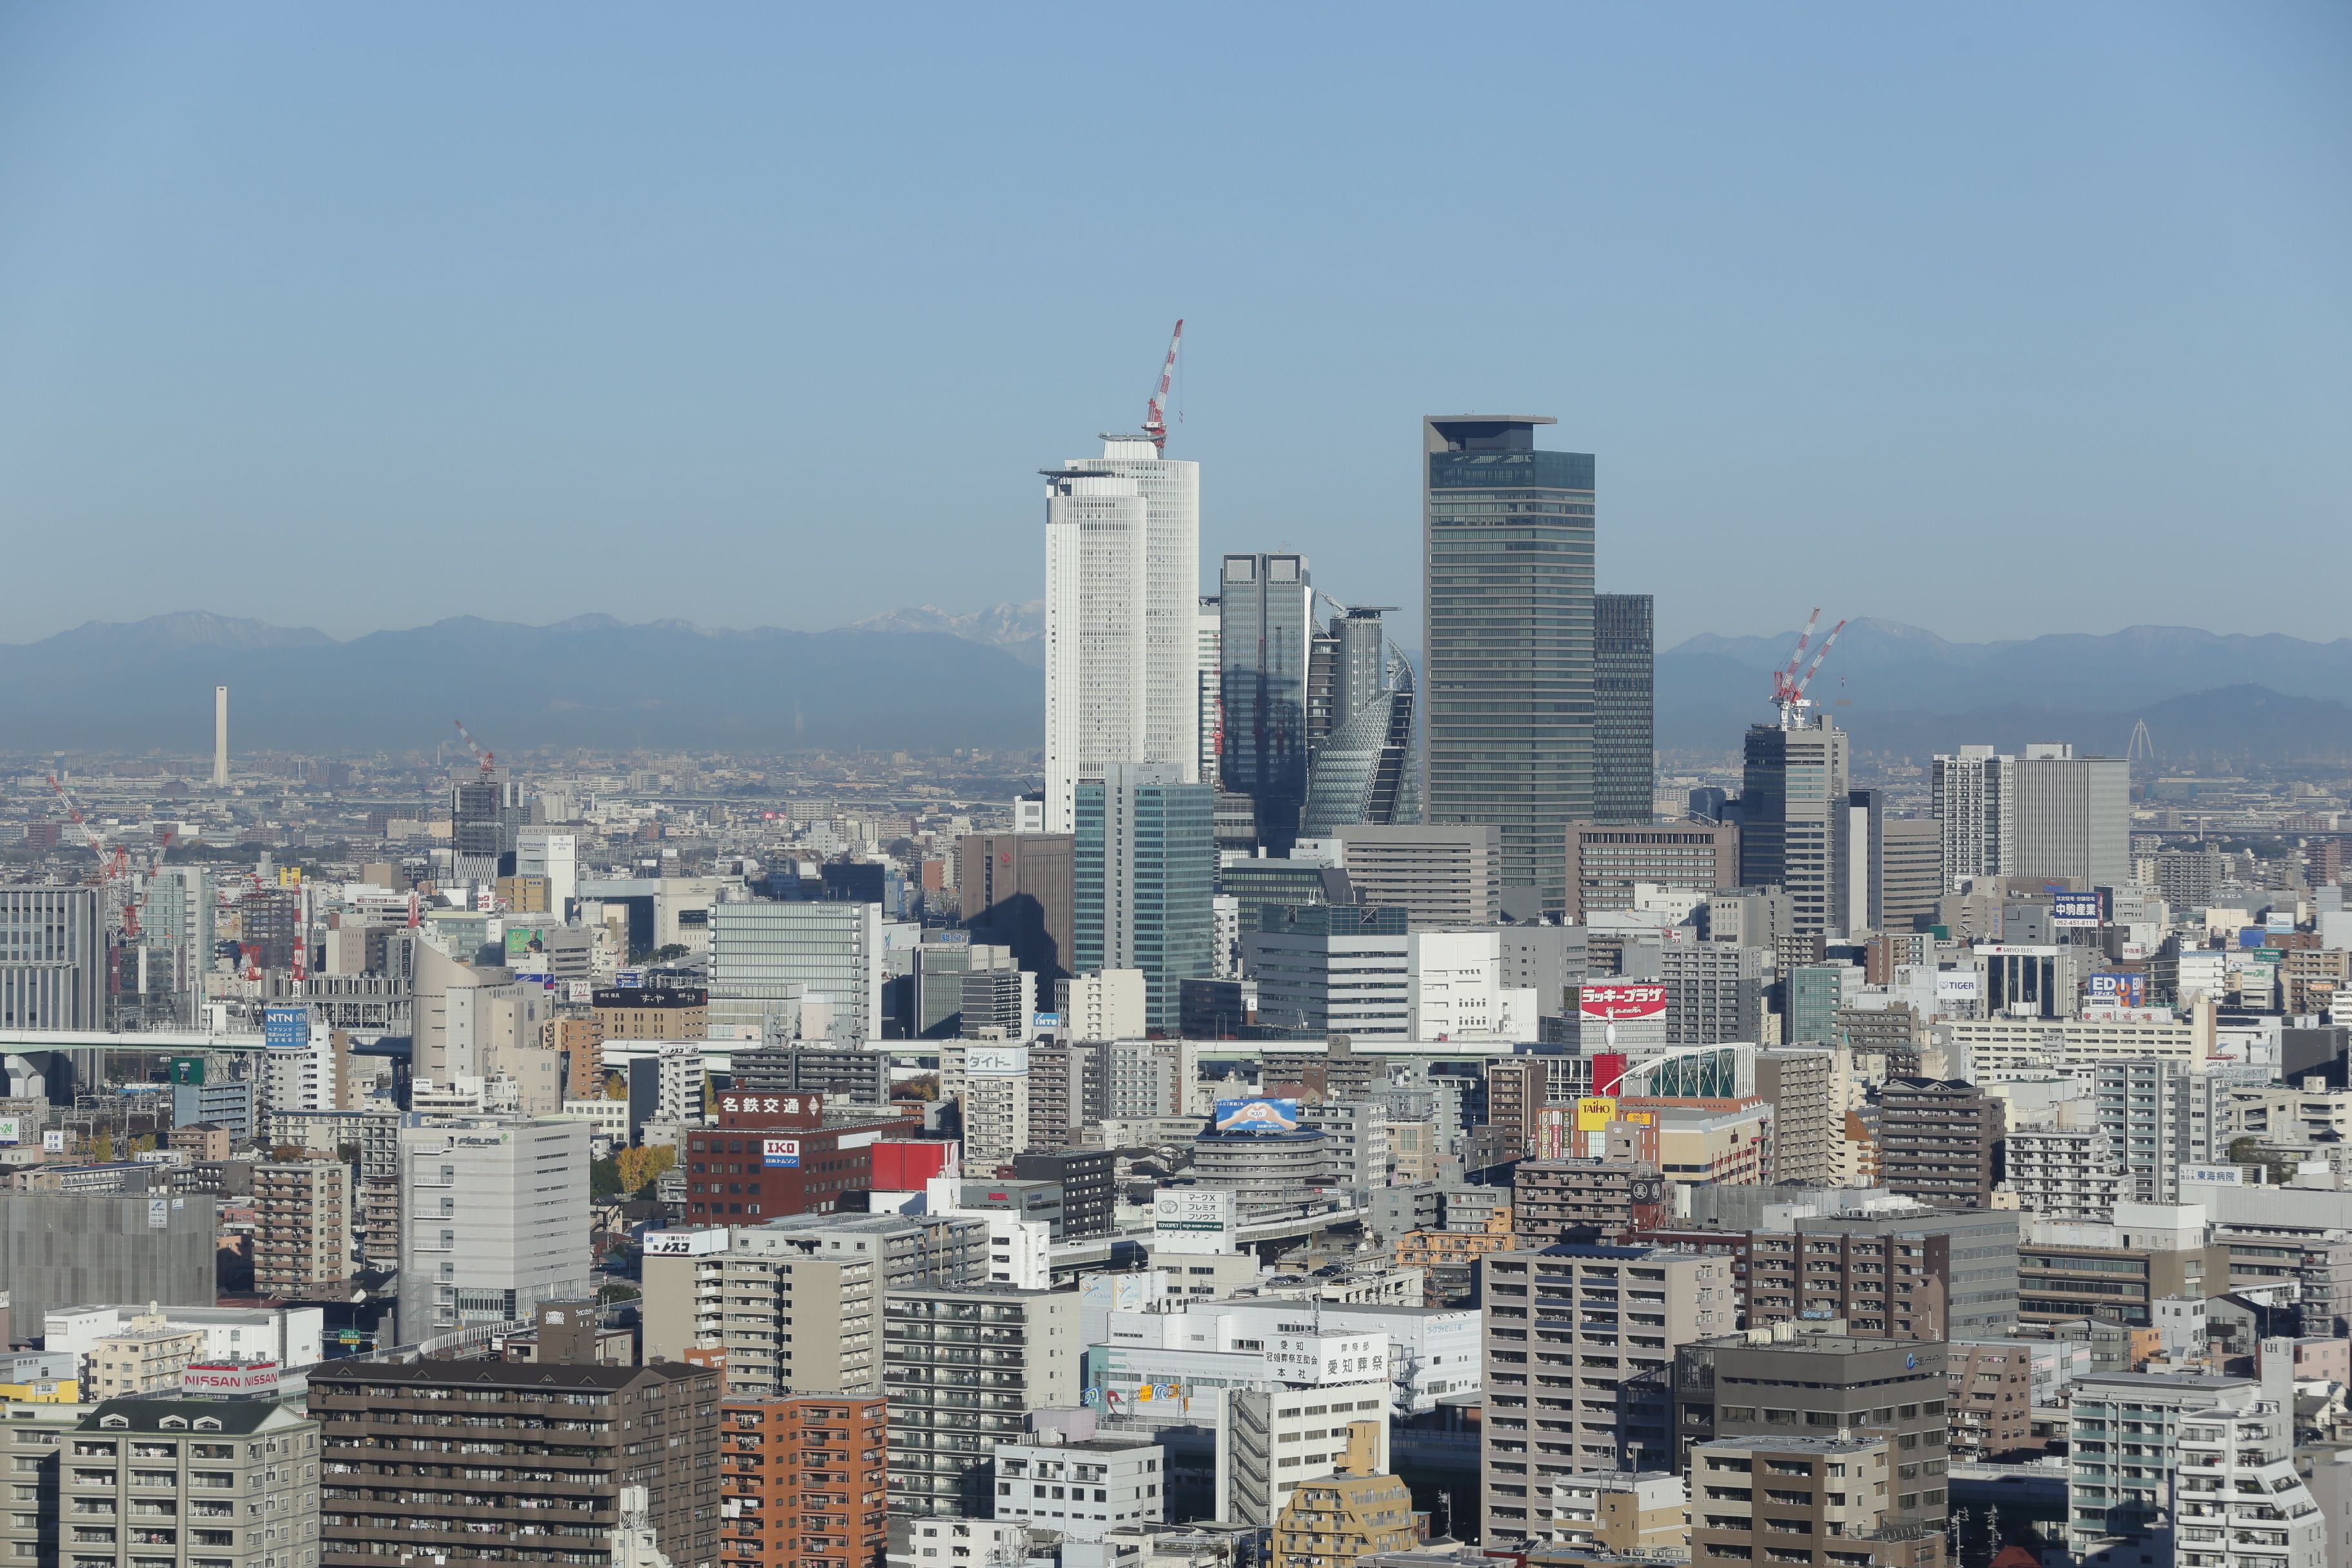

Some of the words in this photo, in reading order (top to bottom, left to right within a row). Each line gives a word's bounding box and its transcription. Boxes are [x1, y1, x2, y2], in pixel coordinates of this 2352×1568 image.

[2056, 903, 2096, 916] 中駒産業
[574, 983, 588, 994] 727
[1582, 988, 1664, 1003] ラッキープラザ
[268, 1013, 293, 1023] NTN
[969, 1056, 1011, 1068] ダイドー
[723, 1097, 799, 1113] 名鉄交通
[767, 1142, 795, 1153] IKO
[2197, 1171, 2235, 1182] 東海病院
[662, 1242, 691, 1253] トスコ
[1280, 1340, 1304, 1351] 愛知
[1341, 1342, 1369, 1353] 葬祭部
[1266, 1352, 1318, 1366] 冠婚葬祭互助会
[1328, 1355, 1382, 1375] 愛知葬祭
[1277, 1367, 1306, 1379] 本社
[185, 1375, 240, 1387] NISSAN
[244, 1373, 278, 1387] NISSAN
